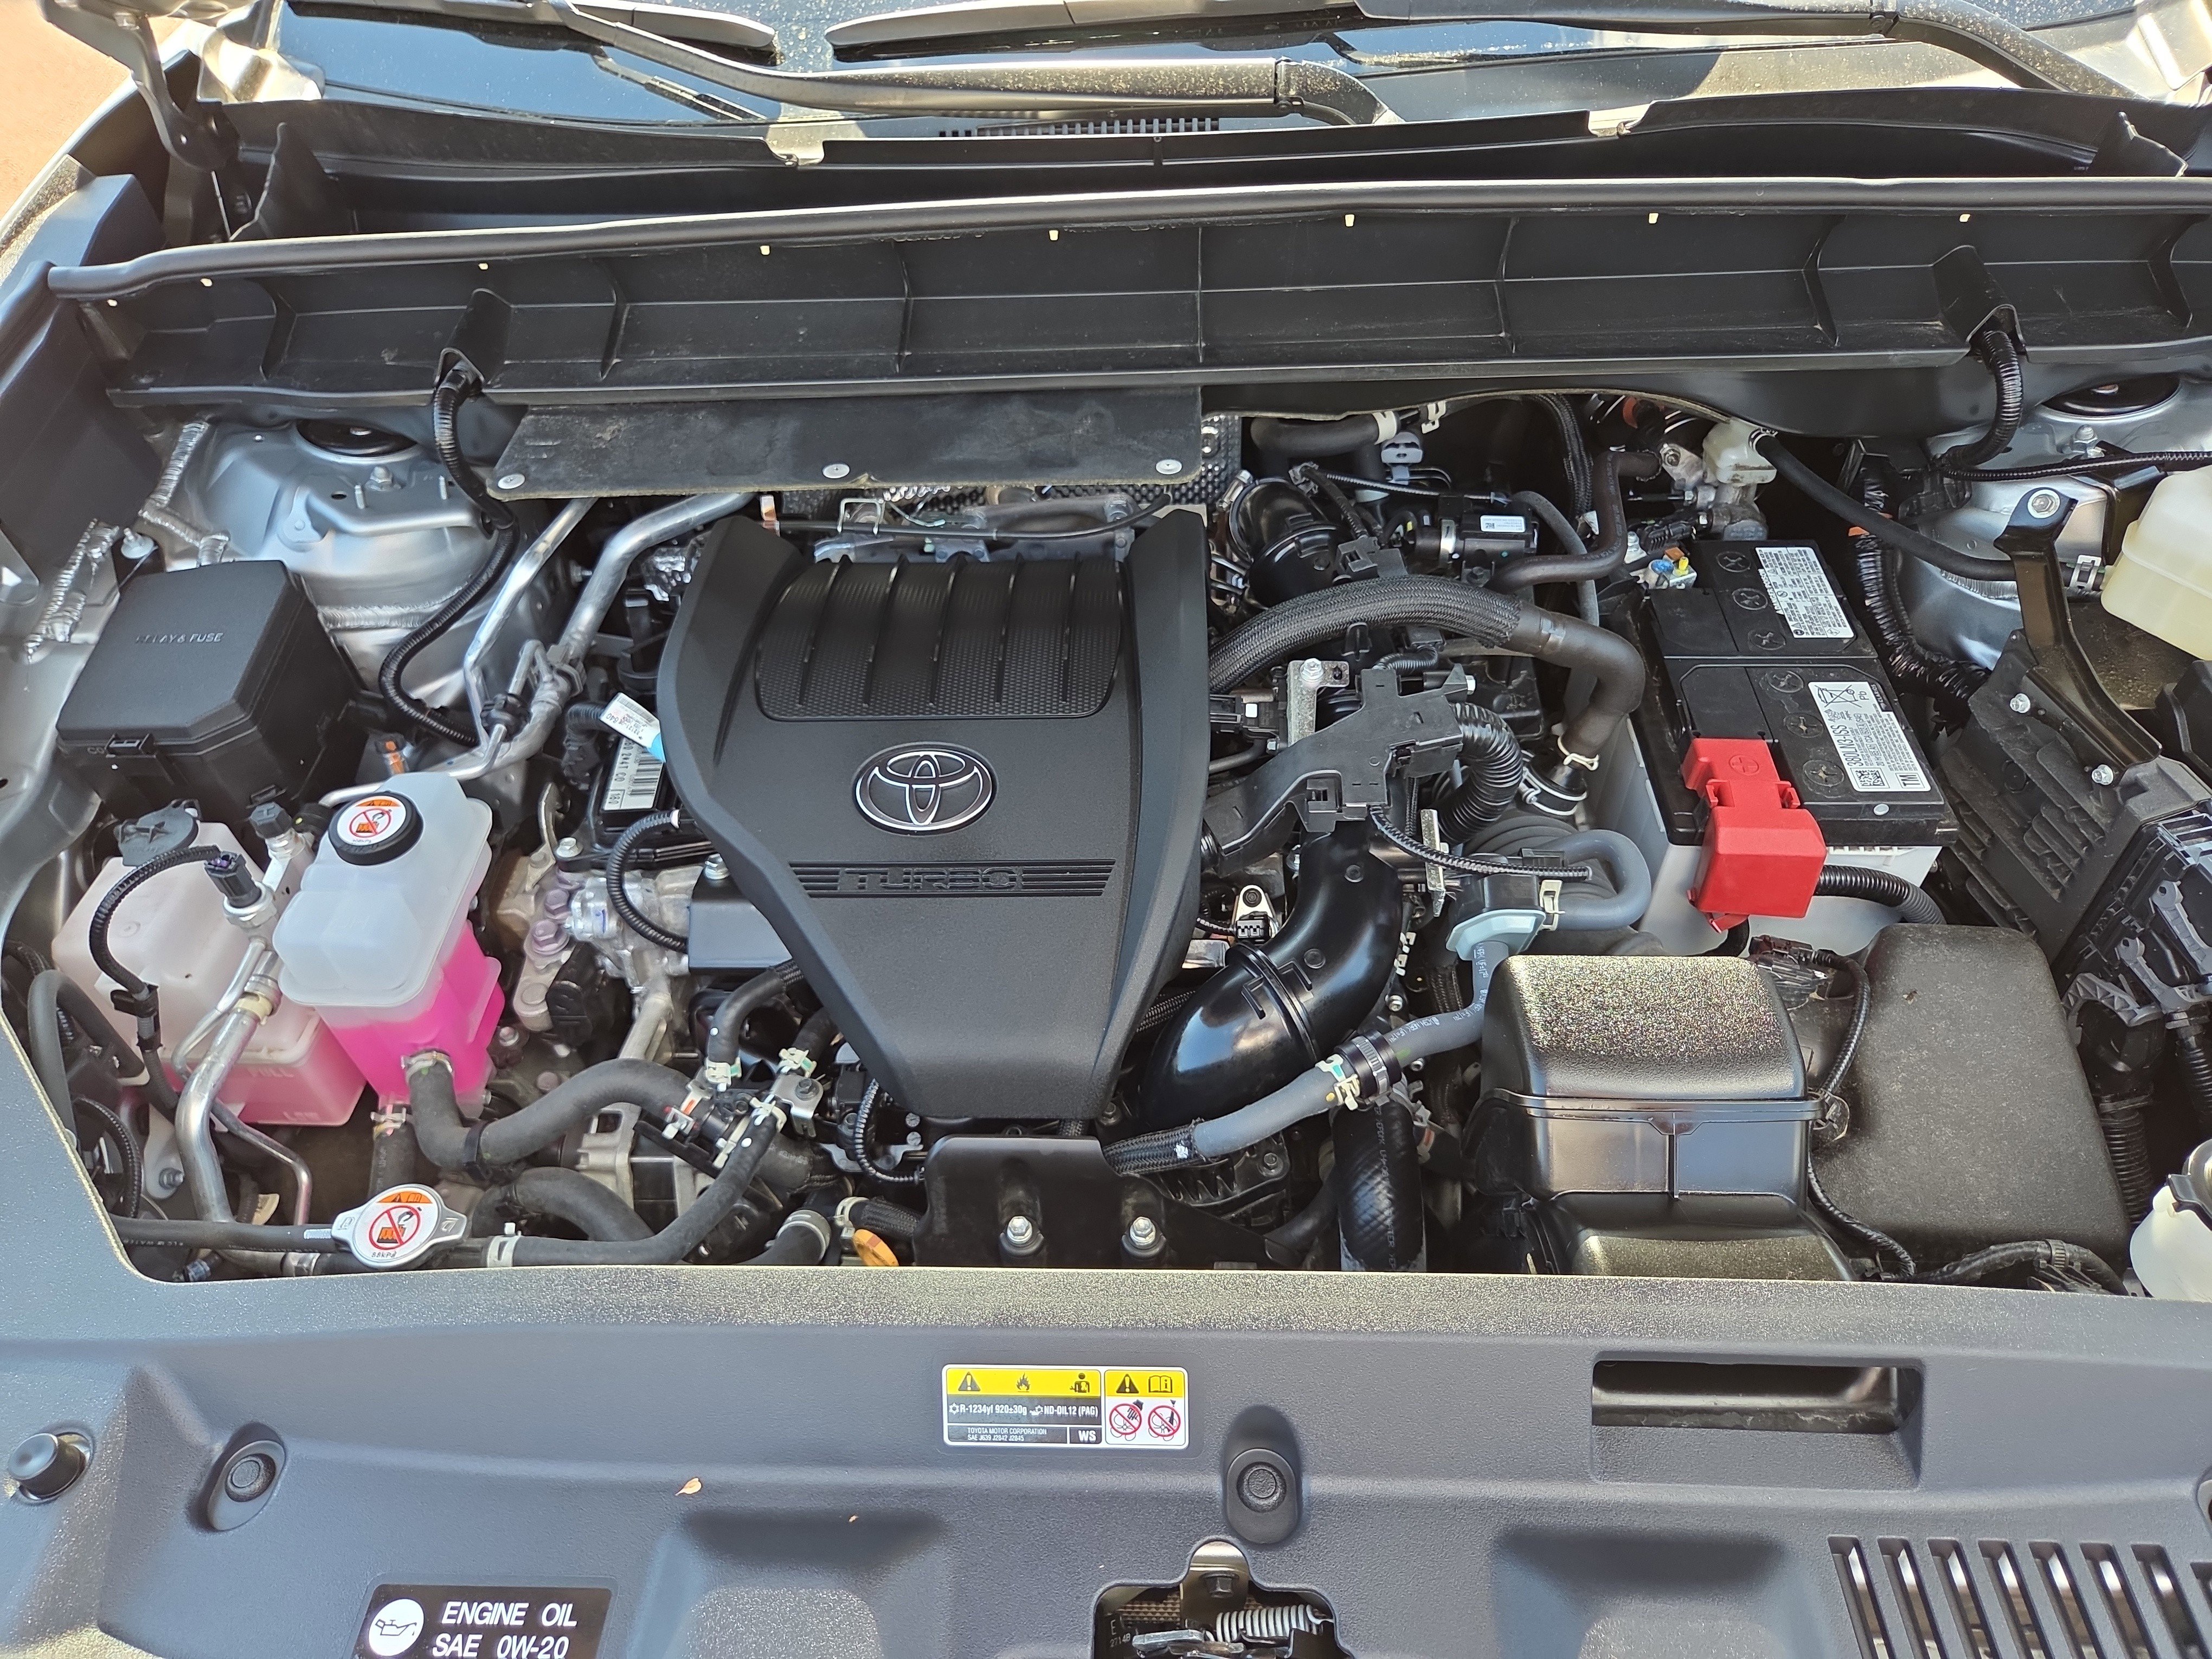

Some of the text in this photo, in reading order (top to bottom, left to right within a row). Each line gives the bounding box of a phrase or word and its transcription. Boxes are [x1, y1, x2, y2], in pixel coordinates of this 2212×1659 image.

[190, 632, 223, 642] FUSE
[1859, 691, 1869, 700] Pb
[1830, 725, 1863, 766] 380LN3-ISS
[1899, 774, 1921, 786] TM
[845, 867, 1017, 890] TURBO
[994, 1404, 1027, 1416] 920±30g
[1078, 1405, 1098, 1417] (PAG)
[1078, 1430, 1096, 1442] WS
[441, 1601, 577, 1626] ENGINE OIL
[432, 1634, 569, 1658] SAE 0W-20
